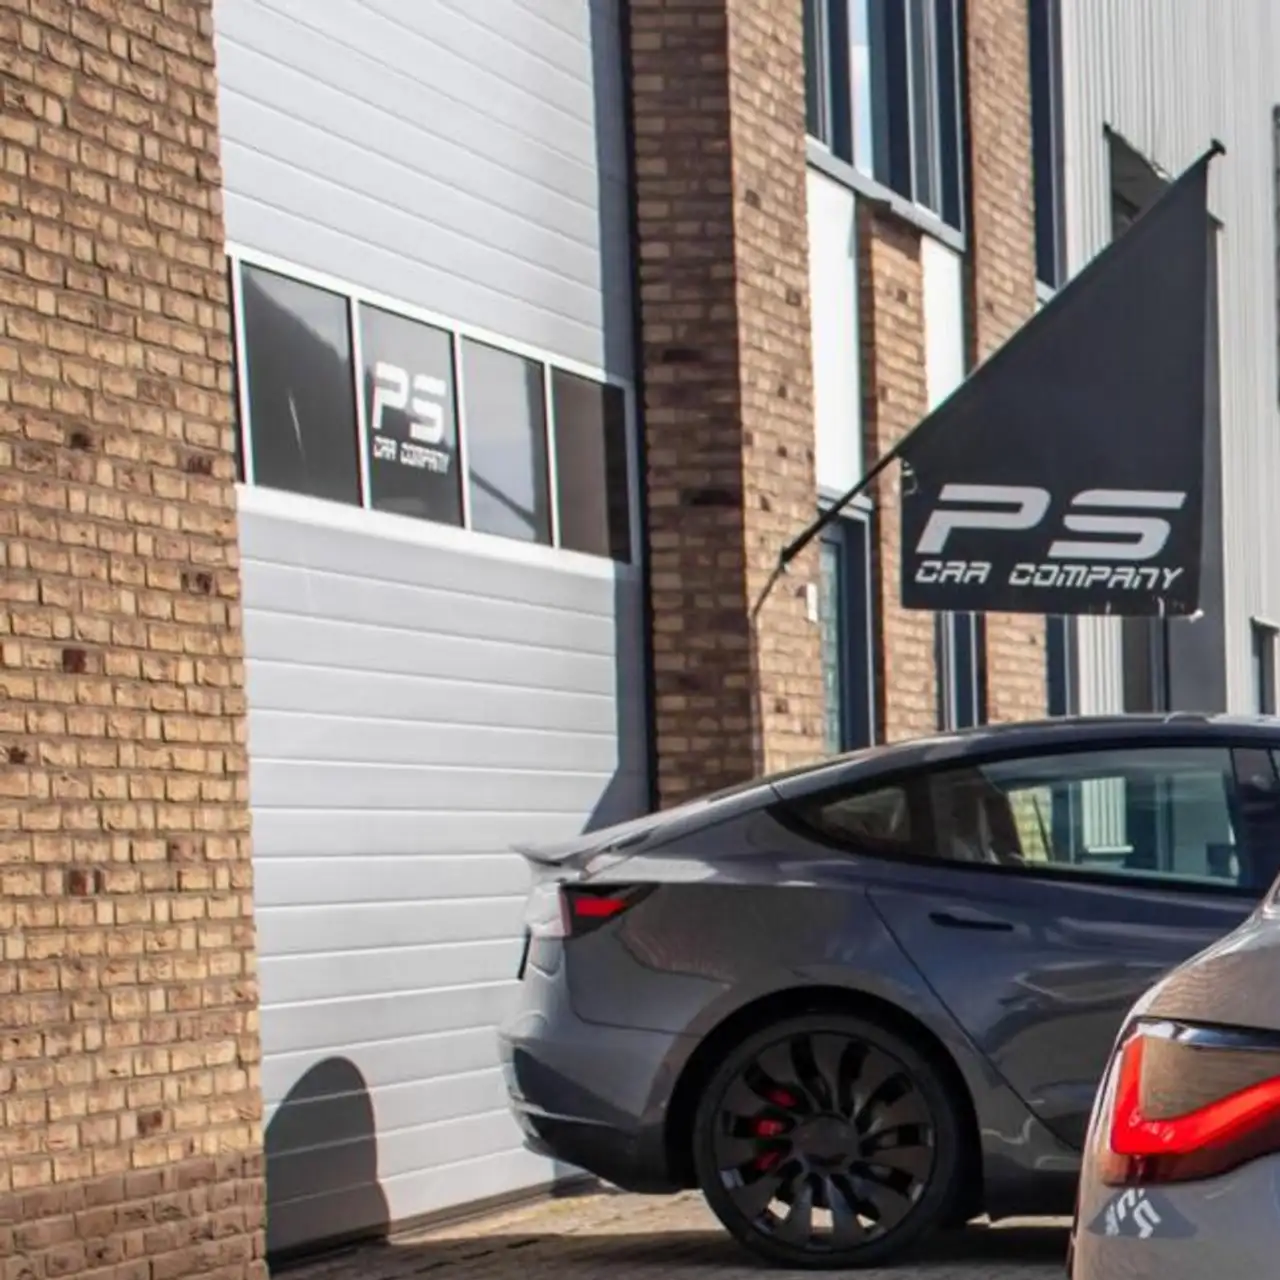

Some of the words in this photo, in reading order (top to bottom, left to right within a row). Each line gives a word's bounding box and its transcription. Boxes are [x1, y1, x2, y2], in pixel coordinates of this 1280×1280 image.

[372, 361, 447, 444] PS
[915, 484, 1187, 560] PS
[914, 560, 992, 584] CAR
[1008, 562, 1184, 590] COMPANY
